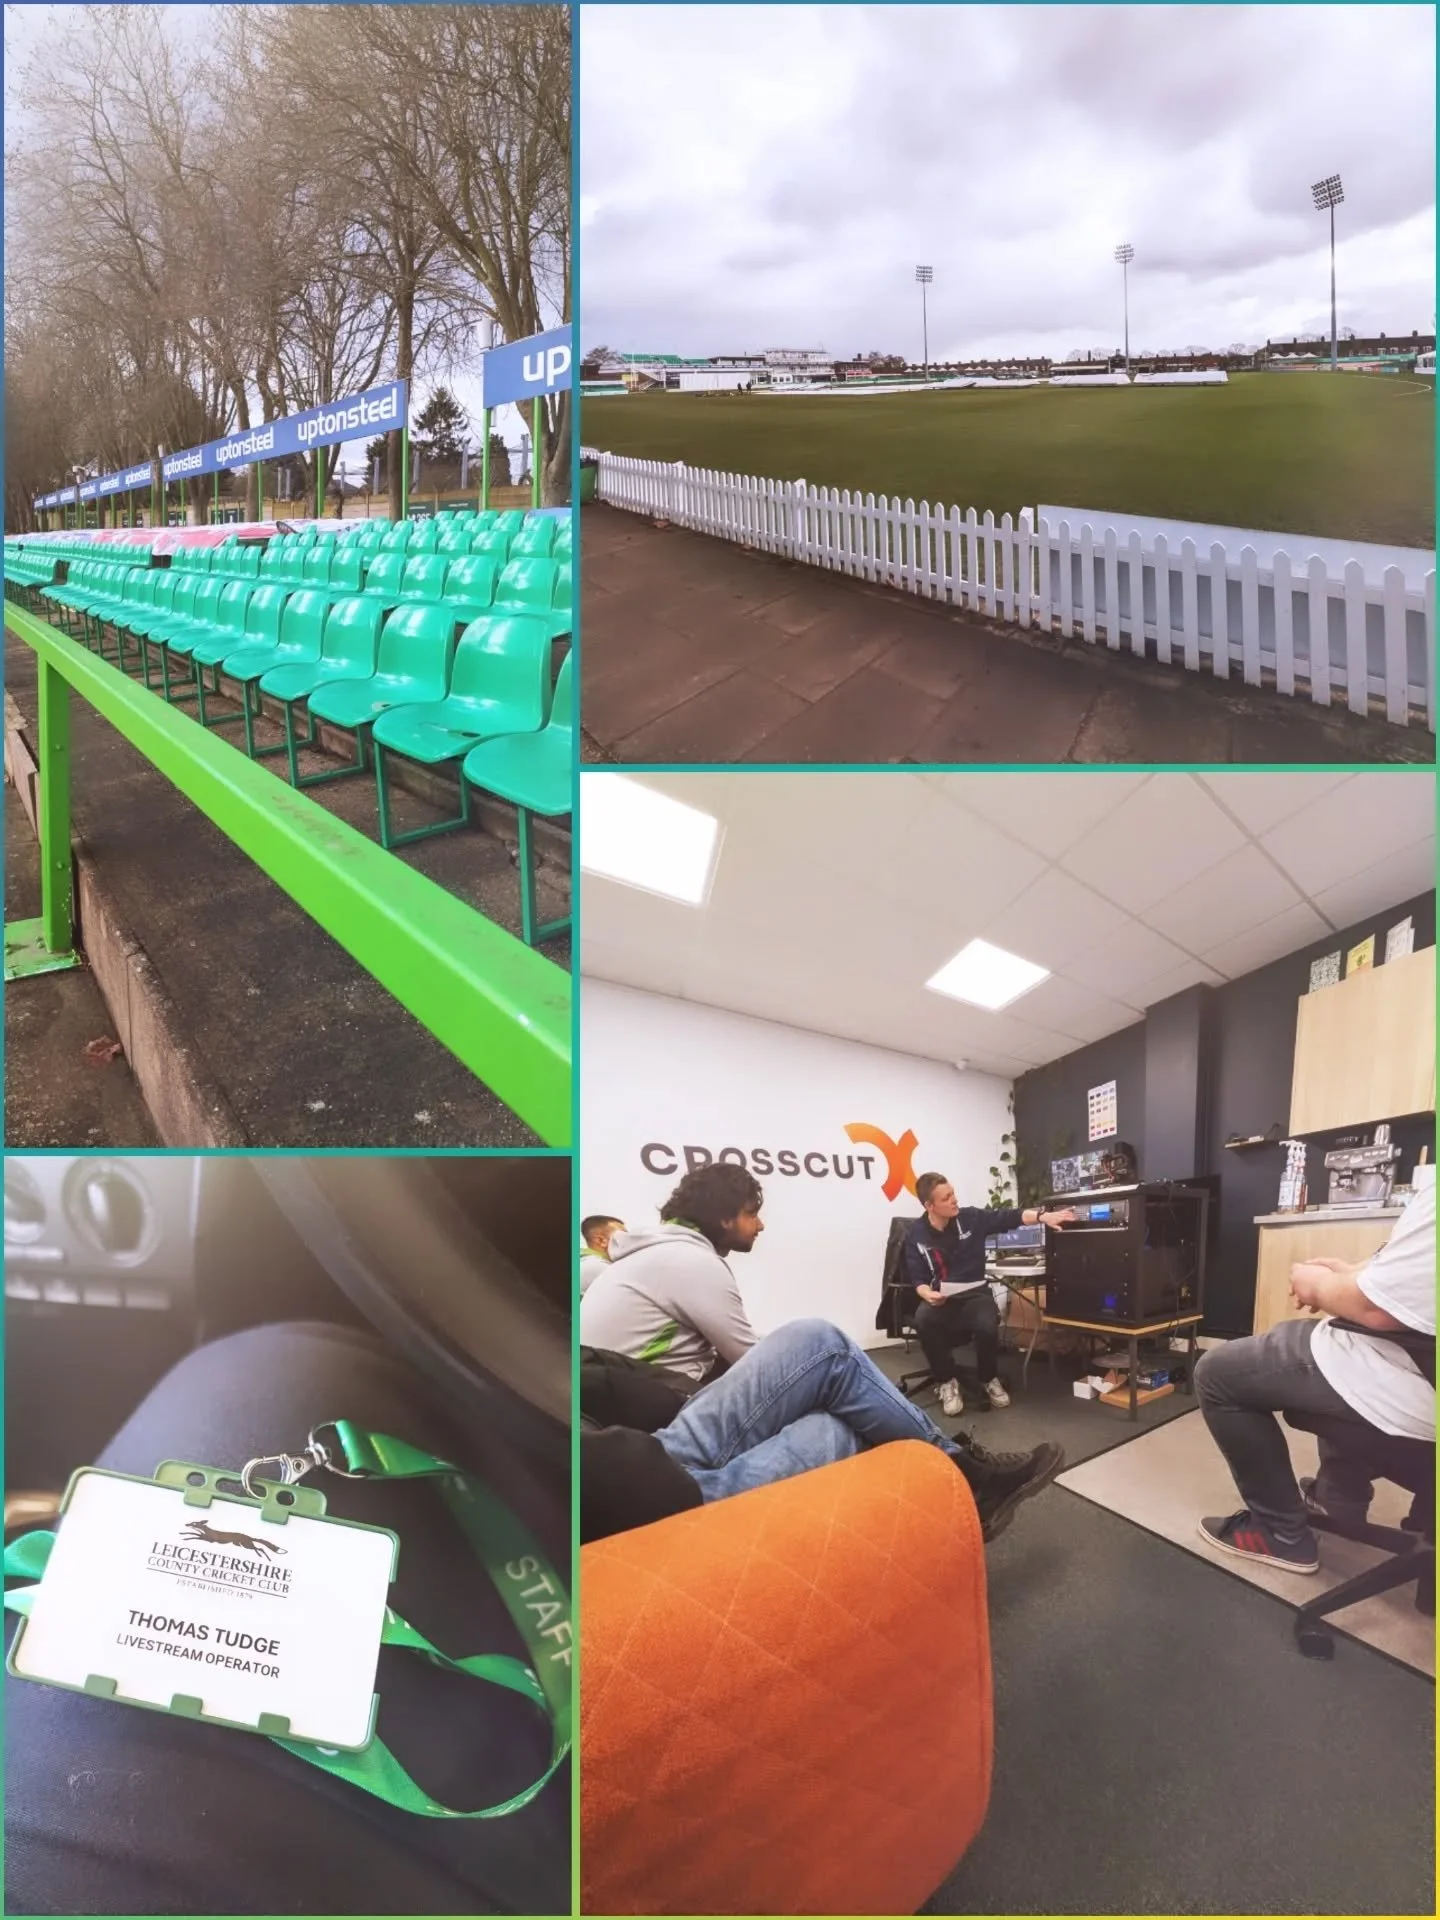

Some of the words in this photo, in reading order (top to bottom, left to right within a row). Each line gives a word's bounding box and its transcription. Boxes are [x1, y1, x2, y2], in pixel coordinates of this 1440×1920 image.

[215, 426, 274, 466] uptonsteel
[297, 387, 398, 445] uptonsteel
[147, 1556, 201, 1574] COUNTY
[202, 1567, 256, 1586] CRICKET
[258, 1579, 290, 1593] CLUB
[151, 1541, 293, 1582] LEICESTERSHIRE
[129, 1609, 210, 1641] THOMAS
[215, 1627, 281, 1656] TUDGE
[116, 1633, 203, 1662] LIVESTREAM
[205, 1652, 280, 1679] OPERATOR
